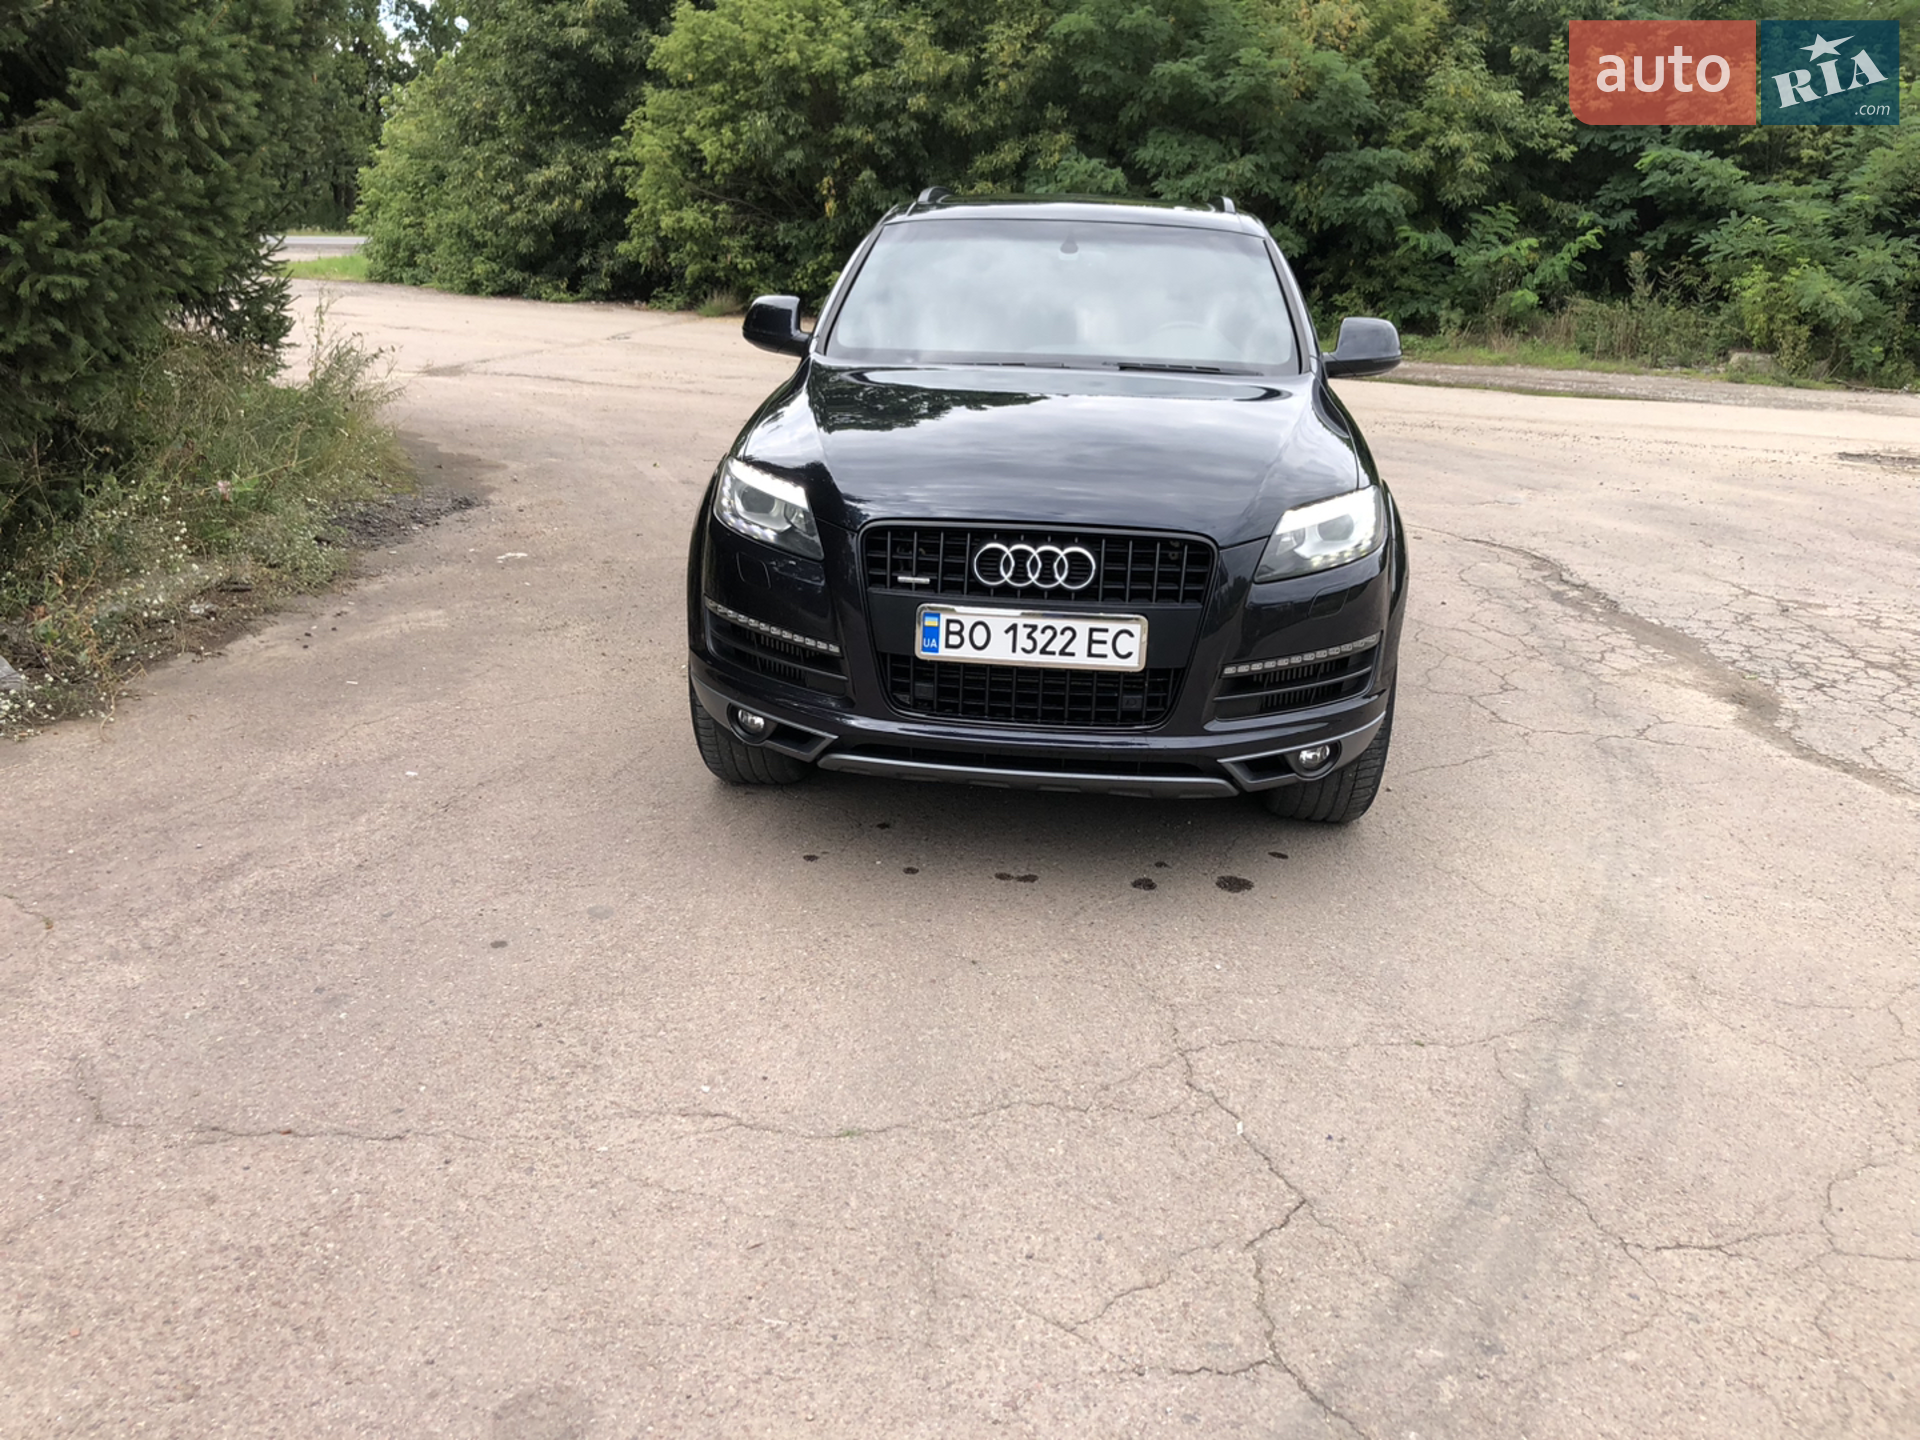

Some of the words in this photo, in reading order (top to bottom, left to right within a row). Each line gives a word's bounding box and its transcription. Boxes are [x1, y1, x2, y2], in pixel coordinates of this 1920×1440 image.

[923, 638, 938, 648] UA
[945, 618, 991, 651] BO
[1004, 622, 1077, 657] 1322
[1087, 627, 1135, 659] EC
